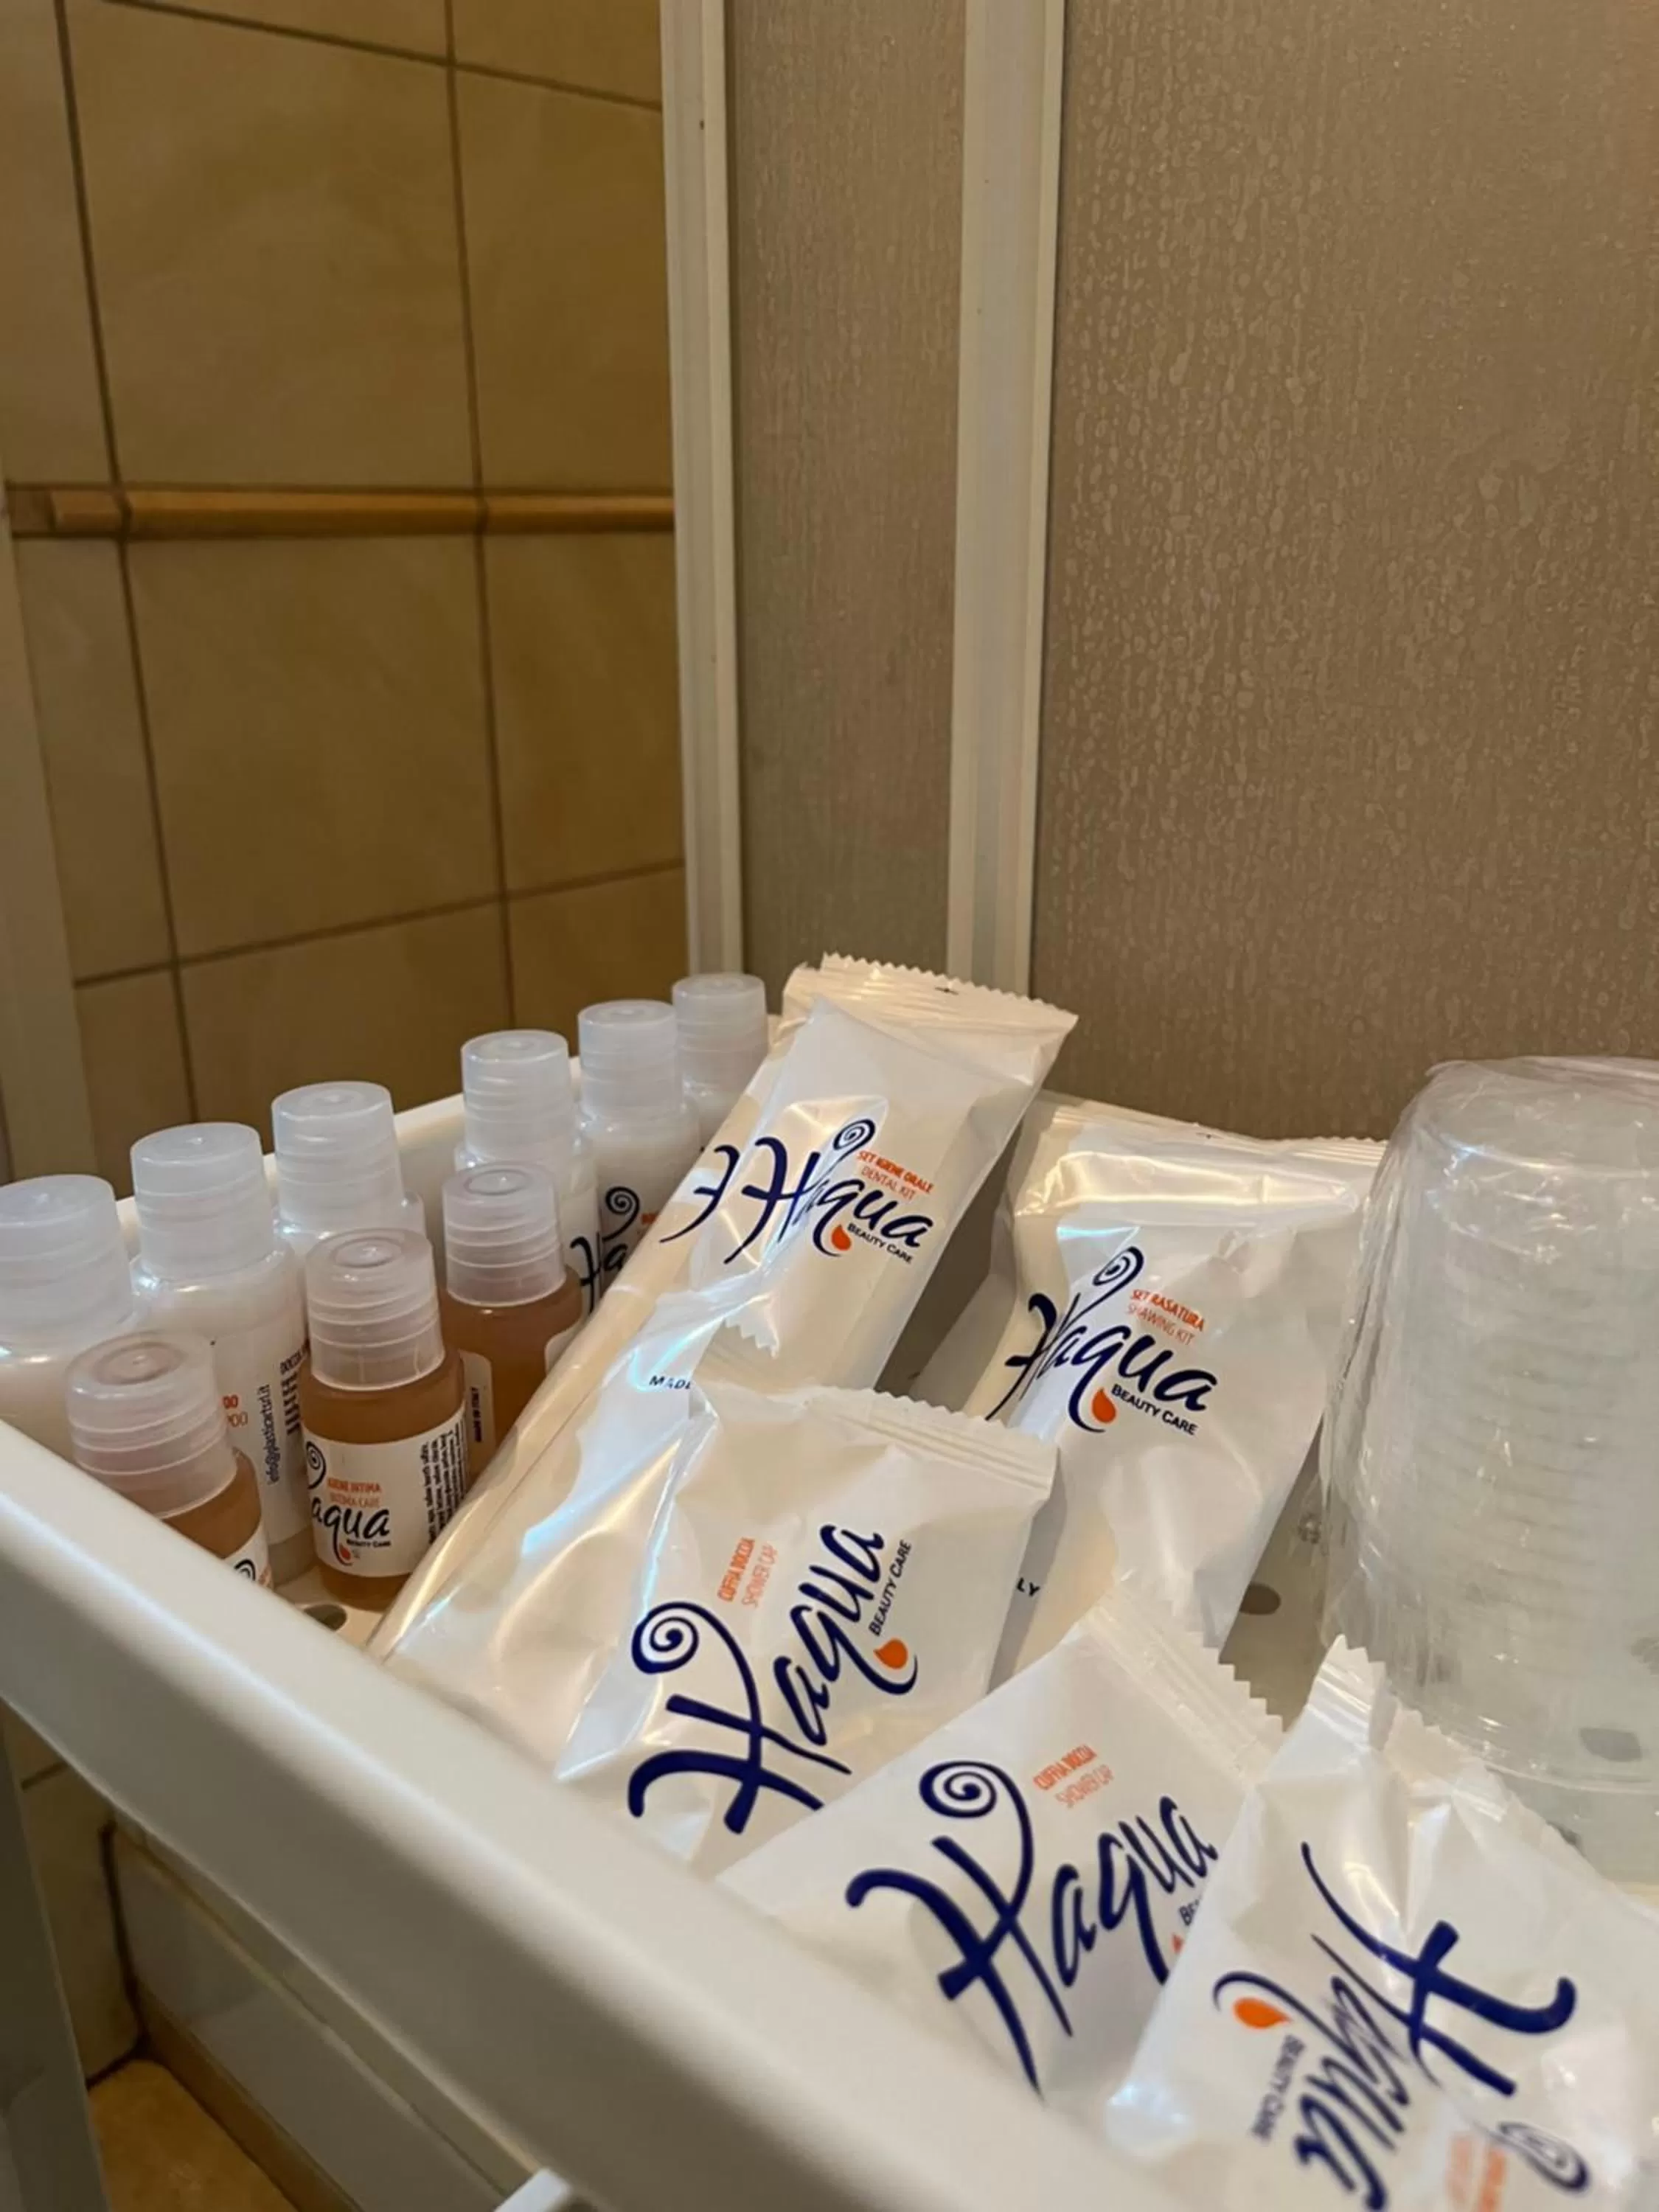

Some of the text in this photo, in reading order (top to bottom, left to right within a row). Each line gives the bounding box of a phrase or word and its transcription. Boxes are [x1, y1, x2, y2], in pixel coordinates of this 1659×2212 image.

[860, 1166, 917, 1200] DENTAL KIT
[848, 1222, 914, 1265] BEAUTY CARE
[985, 1245, 1217, 1433] Haqua
[1175, 1328, 1196, 1346] KIT
[1111, 1382, 1199, 1436] BEAUTY CARE
[869, 1539, 913, 1636] BEAUTY CARE
[627, 1524, 918, 1834] Haqua
[845, 1760, 1219, 2105] Haqua
